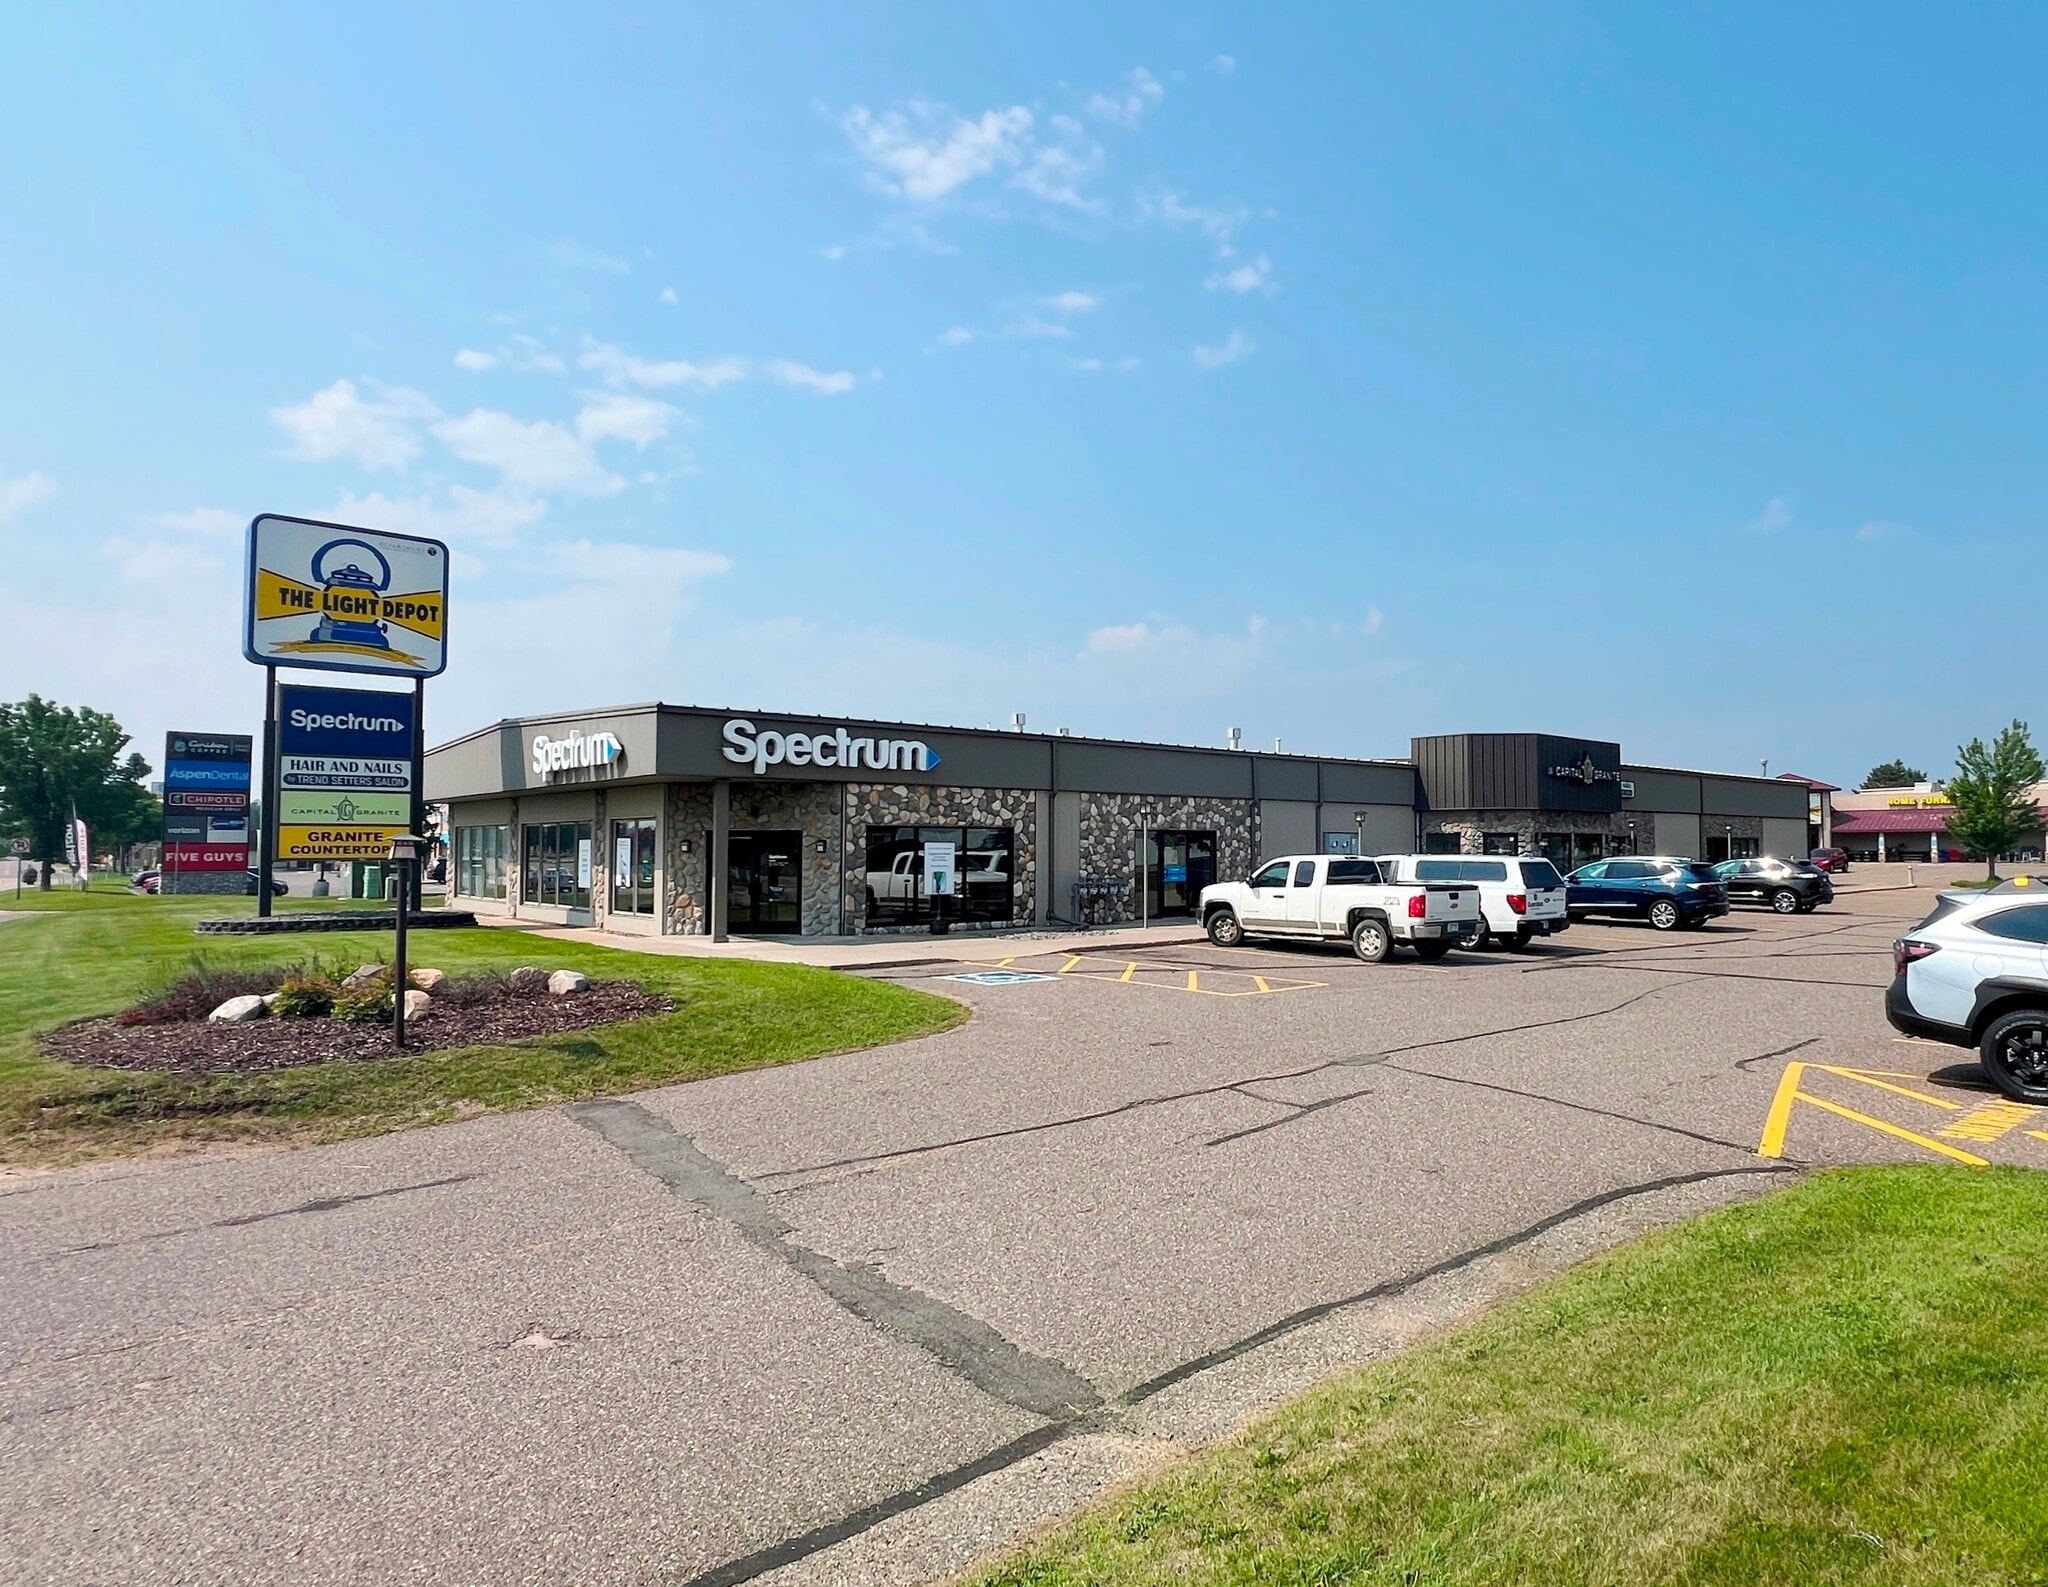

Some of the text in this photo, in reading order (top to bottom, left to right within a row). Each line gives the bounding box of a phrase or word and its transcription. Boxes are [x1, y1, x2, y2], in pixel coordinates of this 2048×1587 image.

[279, 587, 438, 622] THE LIGHT DEPOT
[290, 709, 397, 731] Spectrum
[722, 719, 928, 775] Spectrum
[532, 729, 614, 782] Spectrum
[290, 760, 403, 774] HAIR AND NAILS
[1555, 766, 1583, 778] CAPITAL
[297, 775, 329, 785] TREND
[331, 776, 372, 786] SETTERS
[375, 778, 404, 787] SALON
[186, 795, 242, 804] CHIPOTLE
[1887, 797, 1916, 805] HOME
[308, 832, 384, 842] GRANITE
[165, 852, 244, 861] FIVE GUYS
[290, 846, 391, 855] COUNTERTOP
